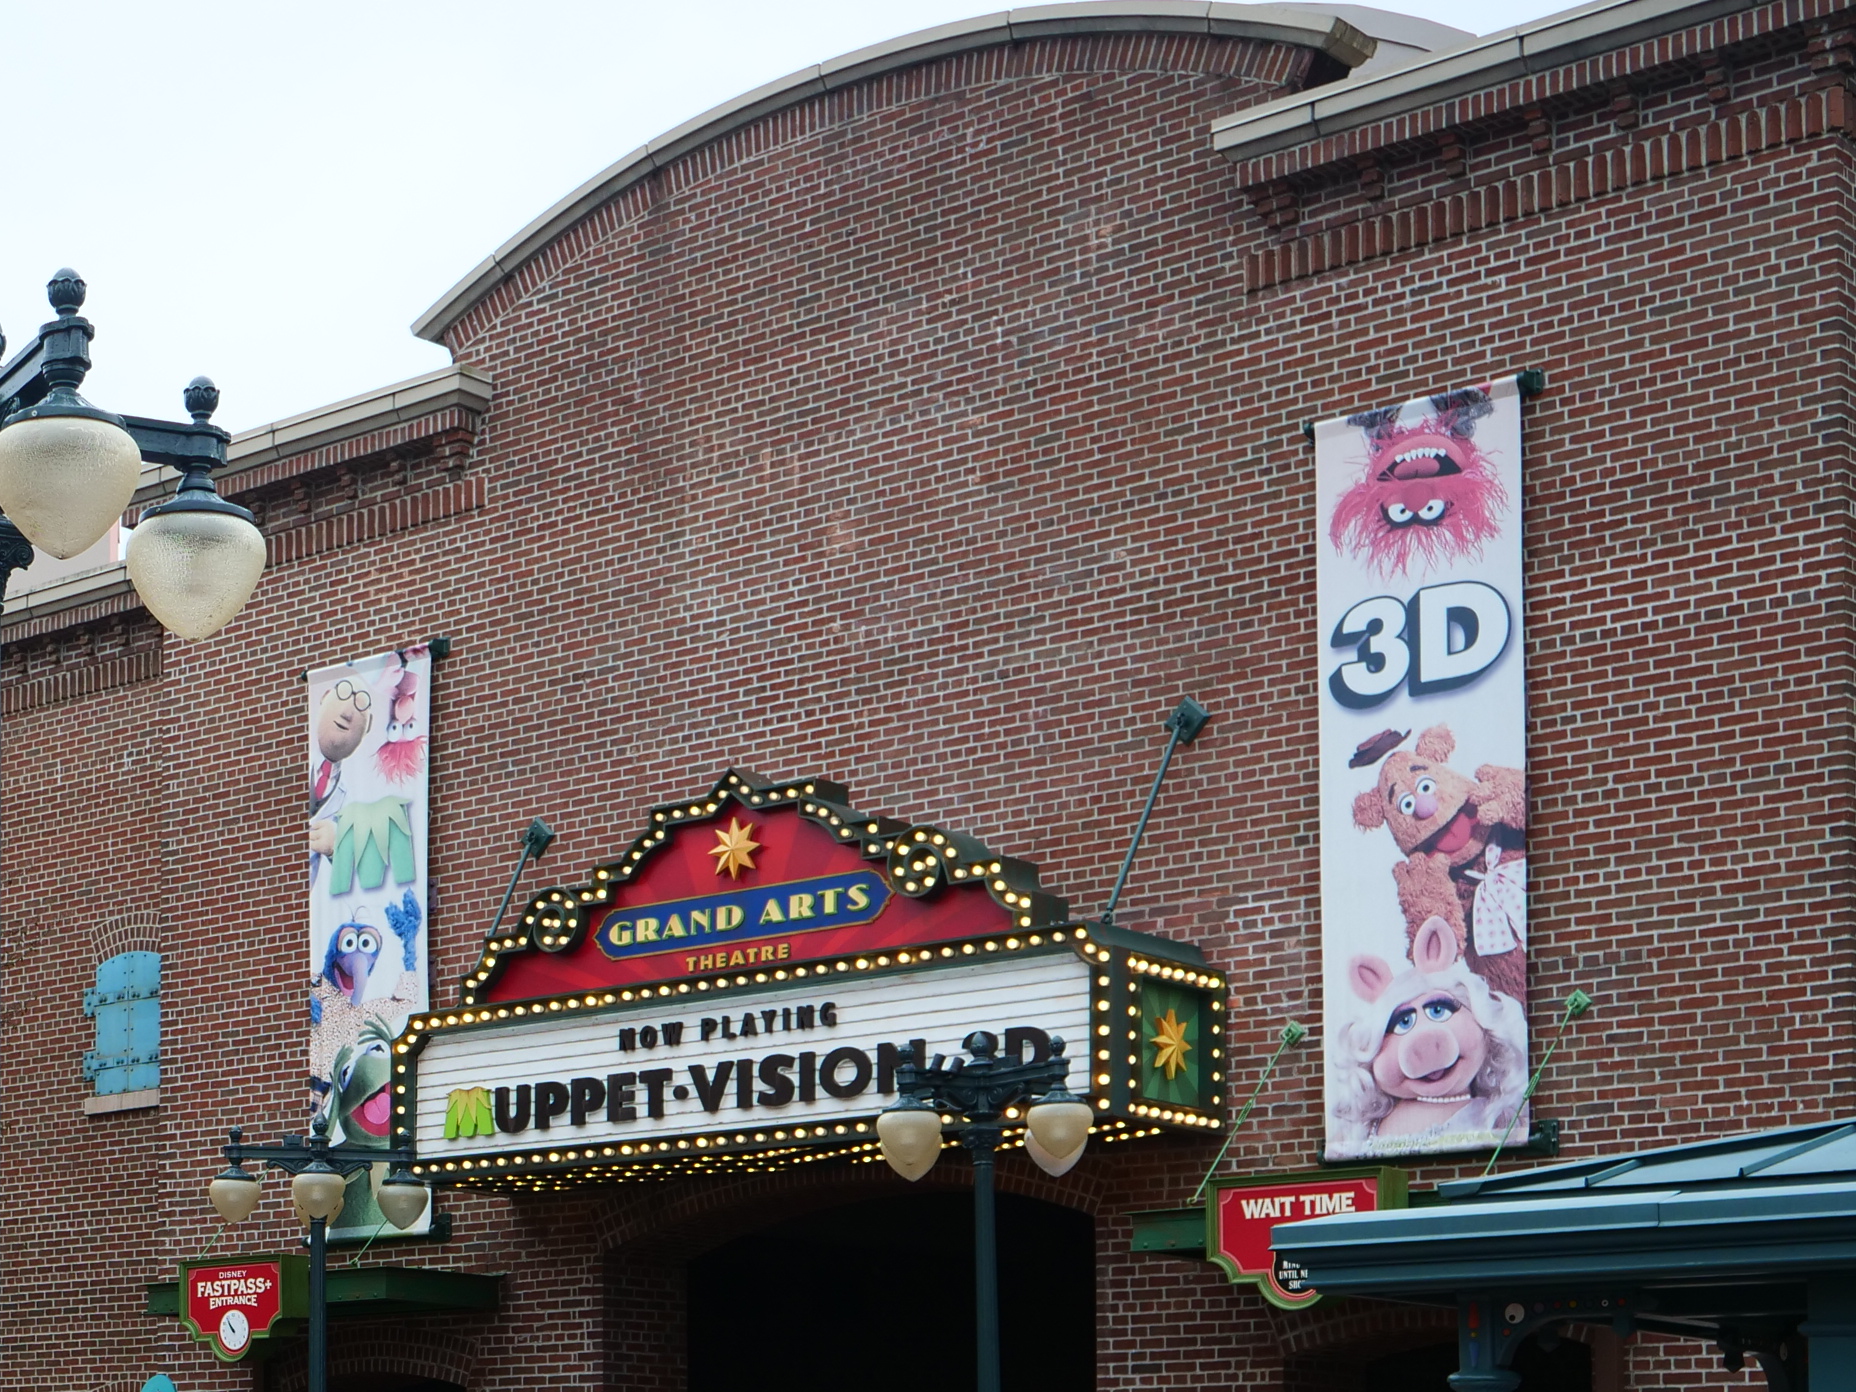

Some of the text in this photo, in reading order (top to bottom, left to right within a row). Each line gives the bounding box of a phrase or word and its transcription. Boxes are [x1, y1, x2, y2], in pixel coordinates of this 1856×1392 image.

[1329, 579, 1512, 710] 3D
[608, 883, 871, 947] GRAND ARTS
[685, 942, 791, 973] THEATRE
[619, 1001, 838, 1052] NOW PLAYING
[1240, 1191, 1356, 1220] WAIT TIME
[197, 1277, 273, 1298] FASTPASS+
[218, 1270, 247, 1279] DISNEY
[1278, 1270, 1299, 1280] UNTIL
[209, 1294, 258, 1310] ENTRANCE
